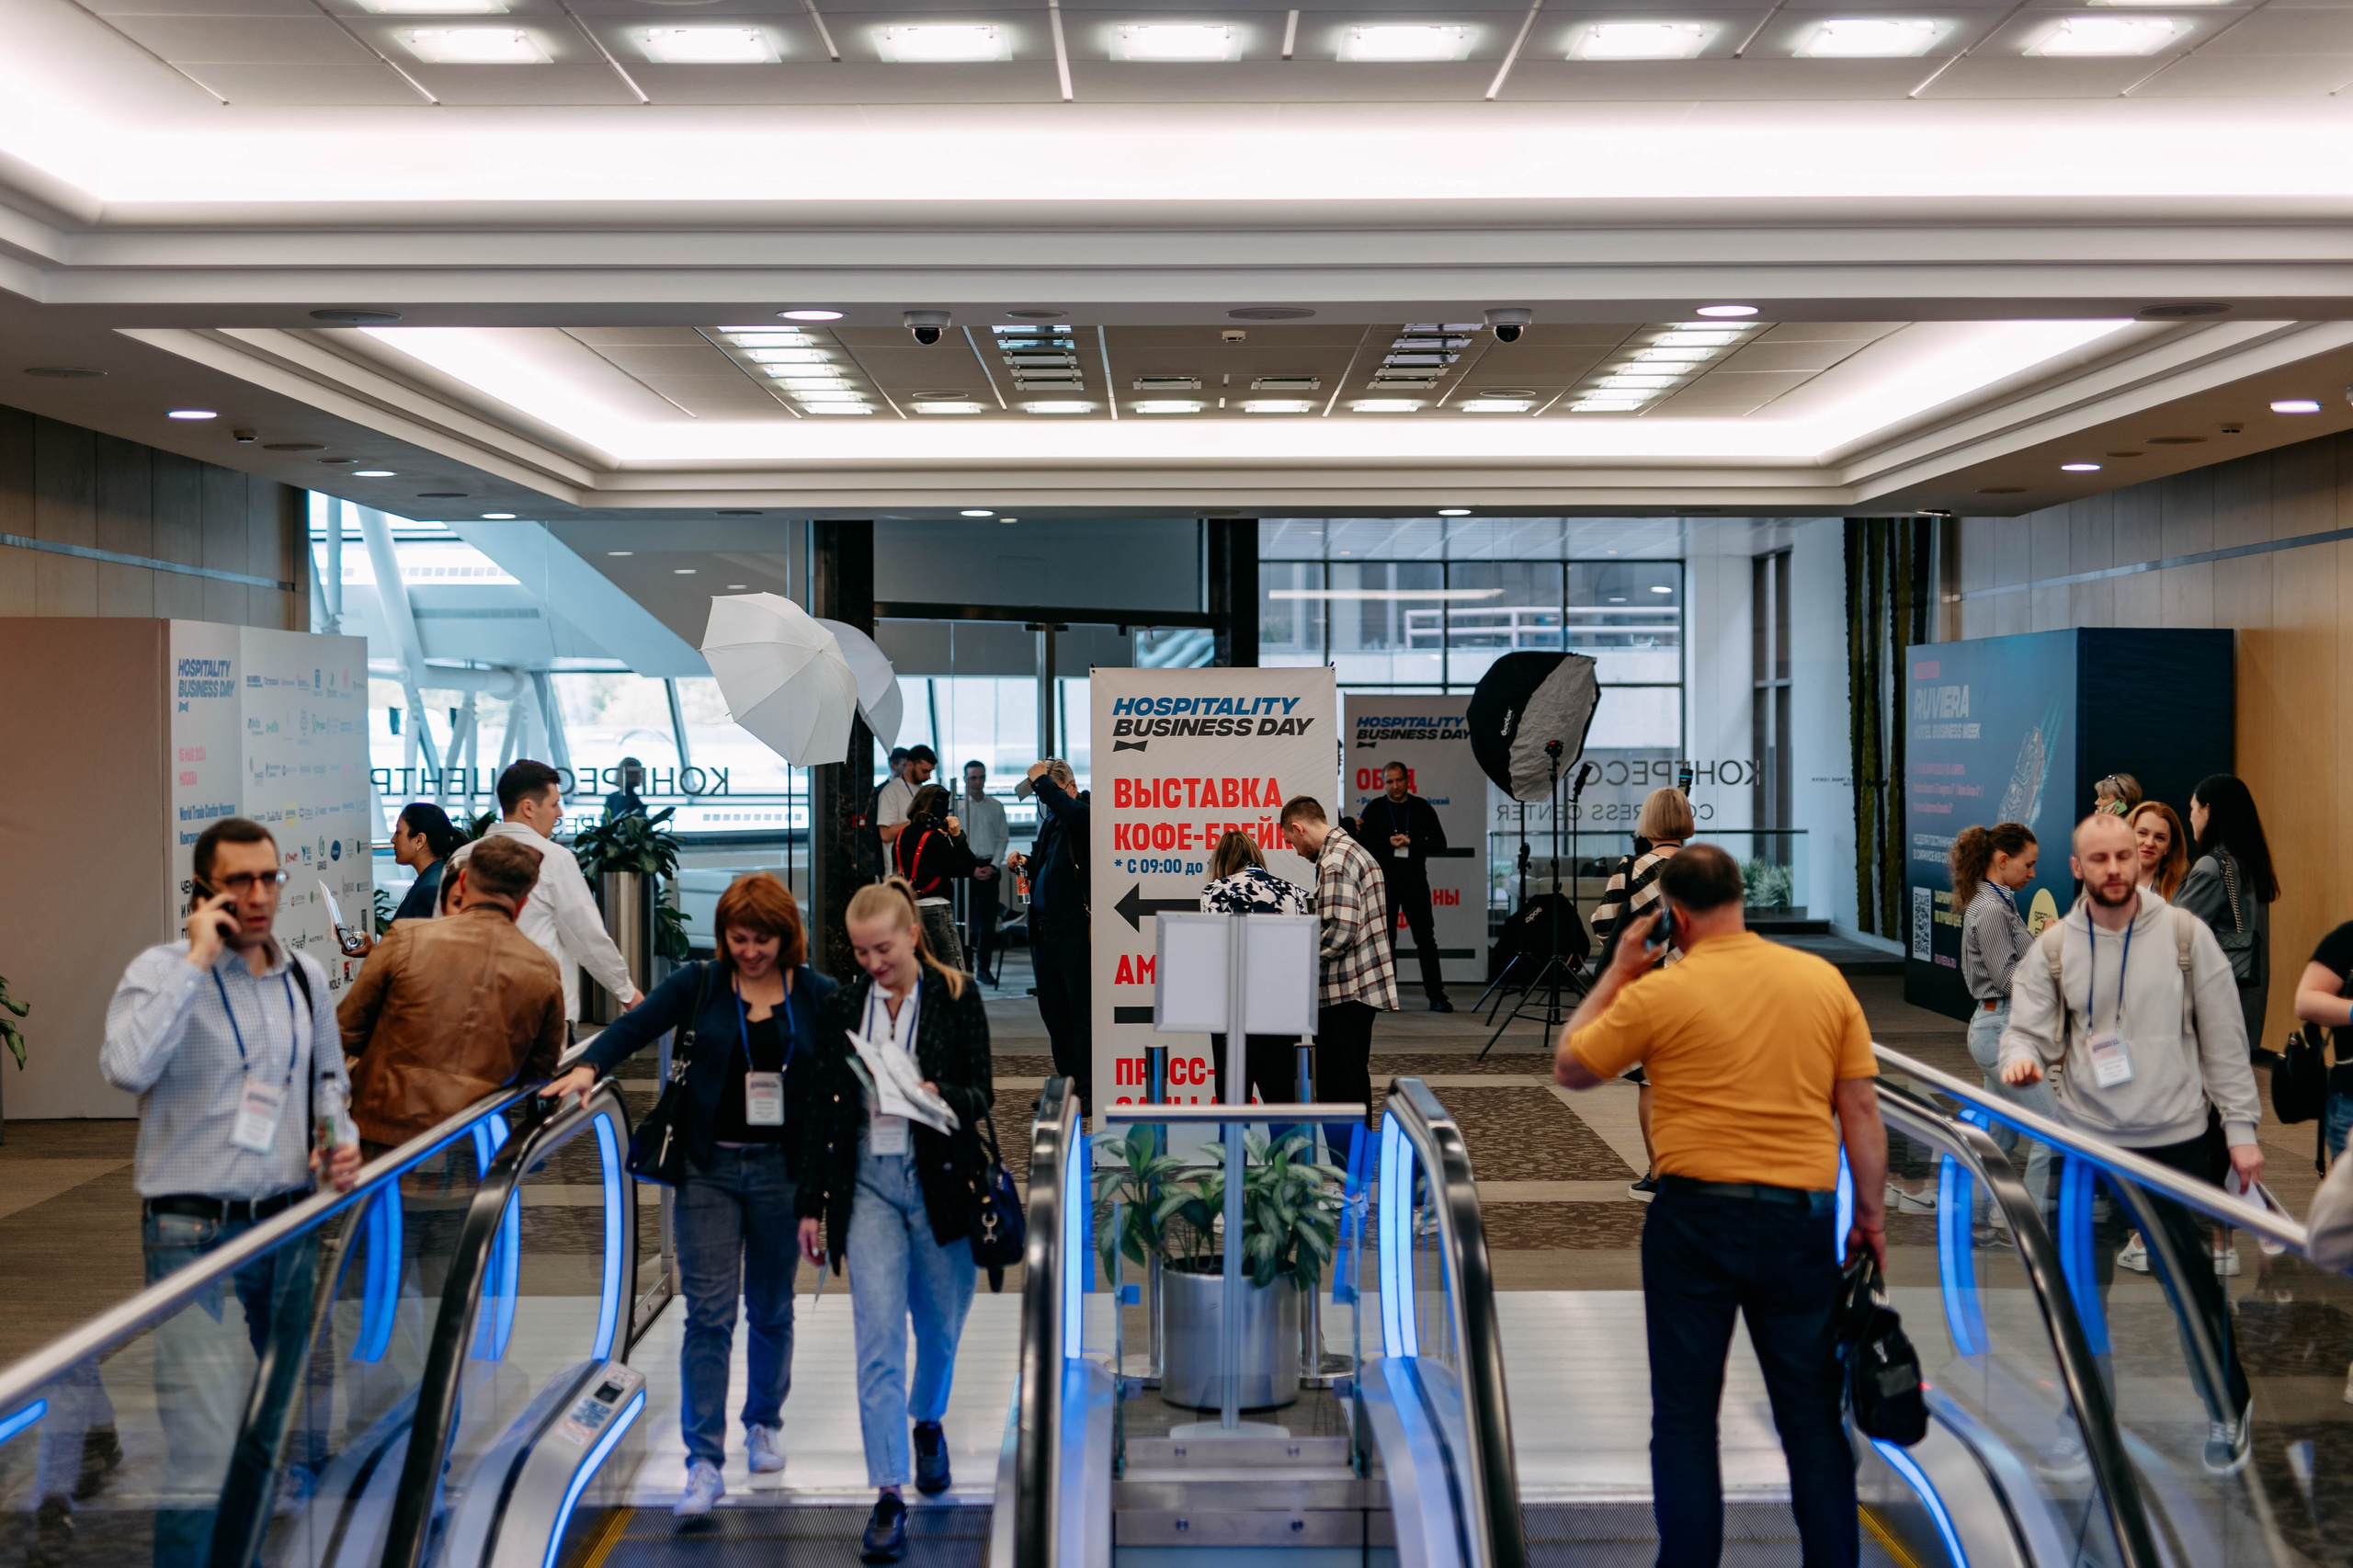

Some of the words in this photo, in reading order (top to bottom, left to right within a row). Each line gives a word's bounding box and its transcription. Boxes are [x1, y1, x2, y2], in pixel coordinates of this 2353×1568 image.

[178, 659, 231, 677] HOSPITALITY
[178, 679, 219, 698] BUSINESS
[219, 680, 235, 698] DAY
[1112, 697, 1301, 716] HOSPITALITY
[1914, 684, 1970, 720] RUVIERA
[1112, 718, 1257, 737] BUSINESS
[1258, 718, 1315, 737] DAY
[1356, 716, 1466, 728] HOSPITALITY
[1501, 709, 1513, 736] Godox
[1962, 723, 1982, 739] WEEK
[1356, 729, 1440, 740] BUSINESS
[1440, 729, 1471, 740] DAY
[1356, 767, 1417, 794] ОБД
[1114, 778, 1283, 808] ВЫСТАВКА
[1127, 858, 1137, 874] С
[1140, 858, 1182, 874] 09:00
[1185, 861, 1203, 876] до
